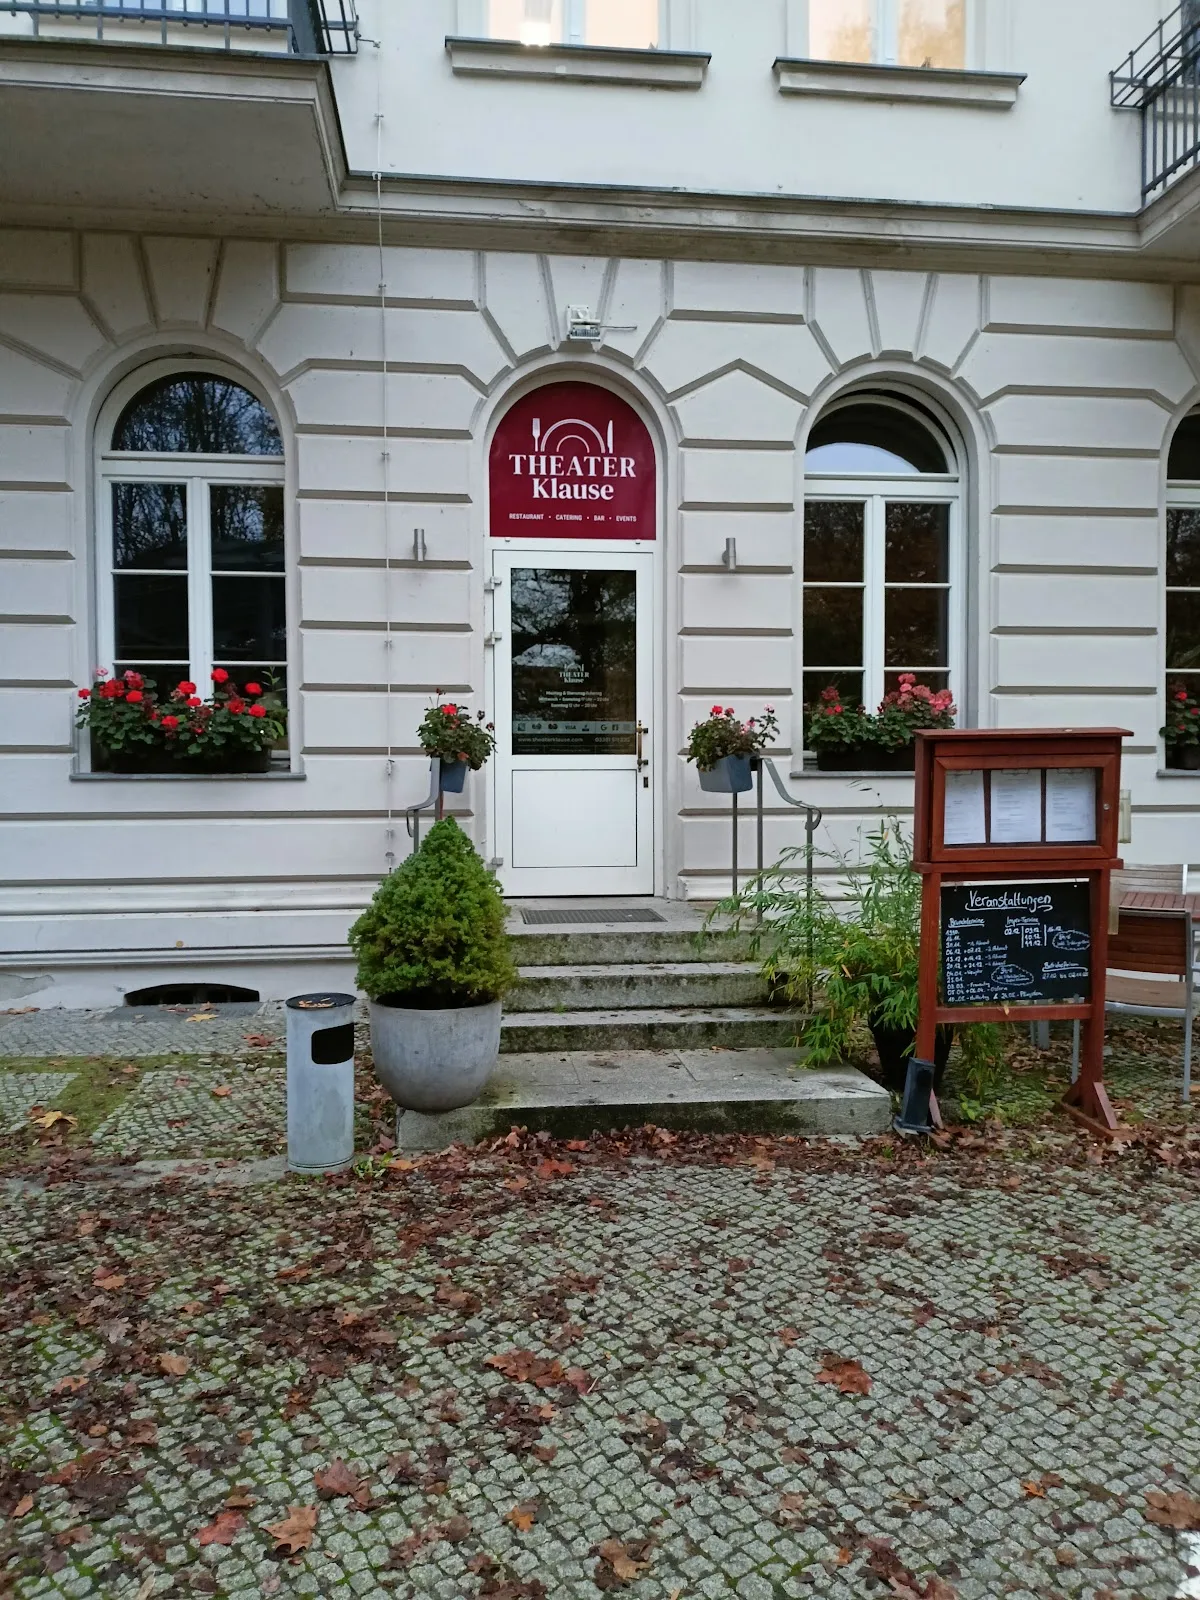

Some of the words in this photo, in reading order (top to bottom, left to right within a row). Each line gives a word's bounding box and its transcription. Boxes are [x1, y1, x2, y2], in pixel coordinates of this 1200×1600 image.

[508, 454, 637, 478] THEATER
[532, 478, 615, 500] Klause
[969, 891, 1051, 912] Veranstaltungen
